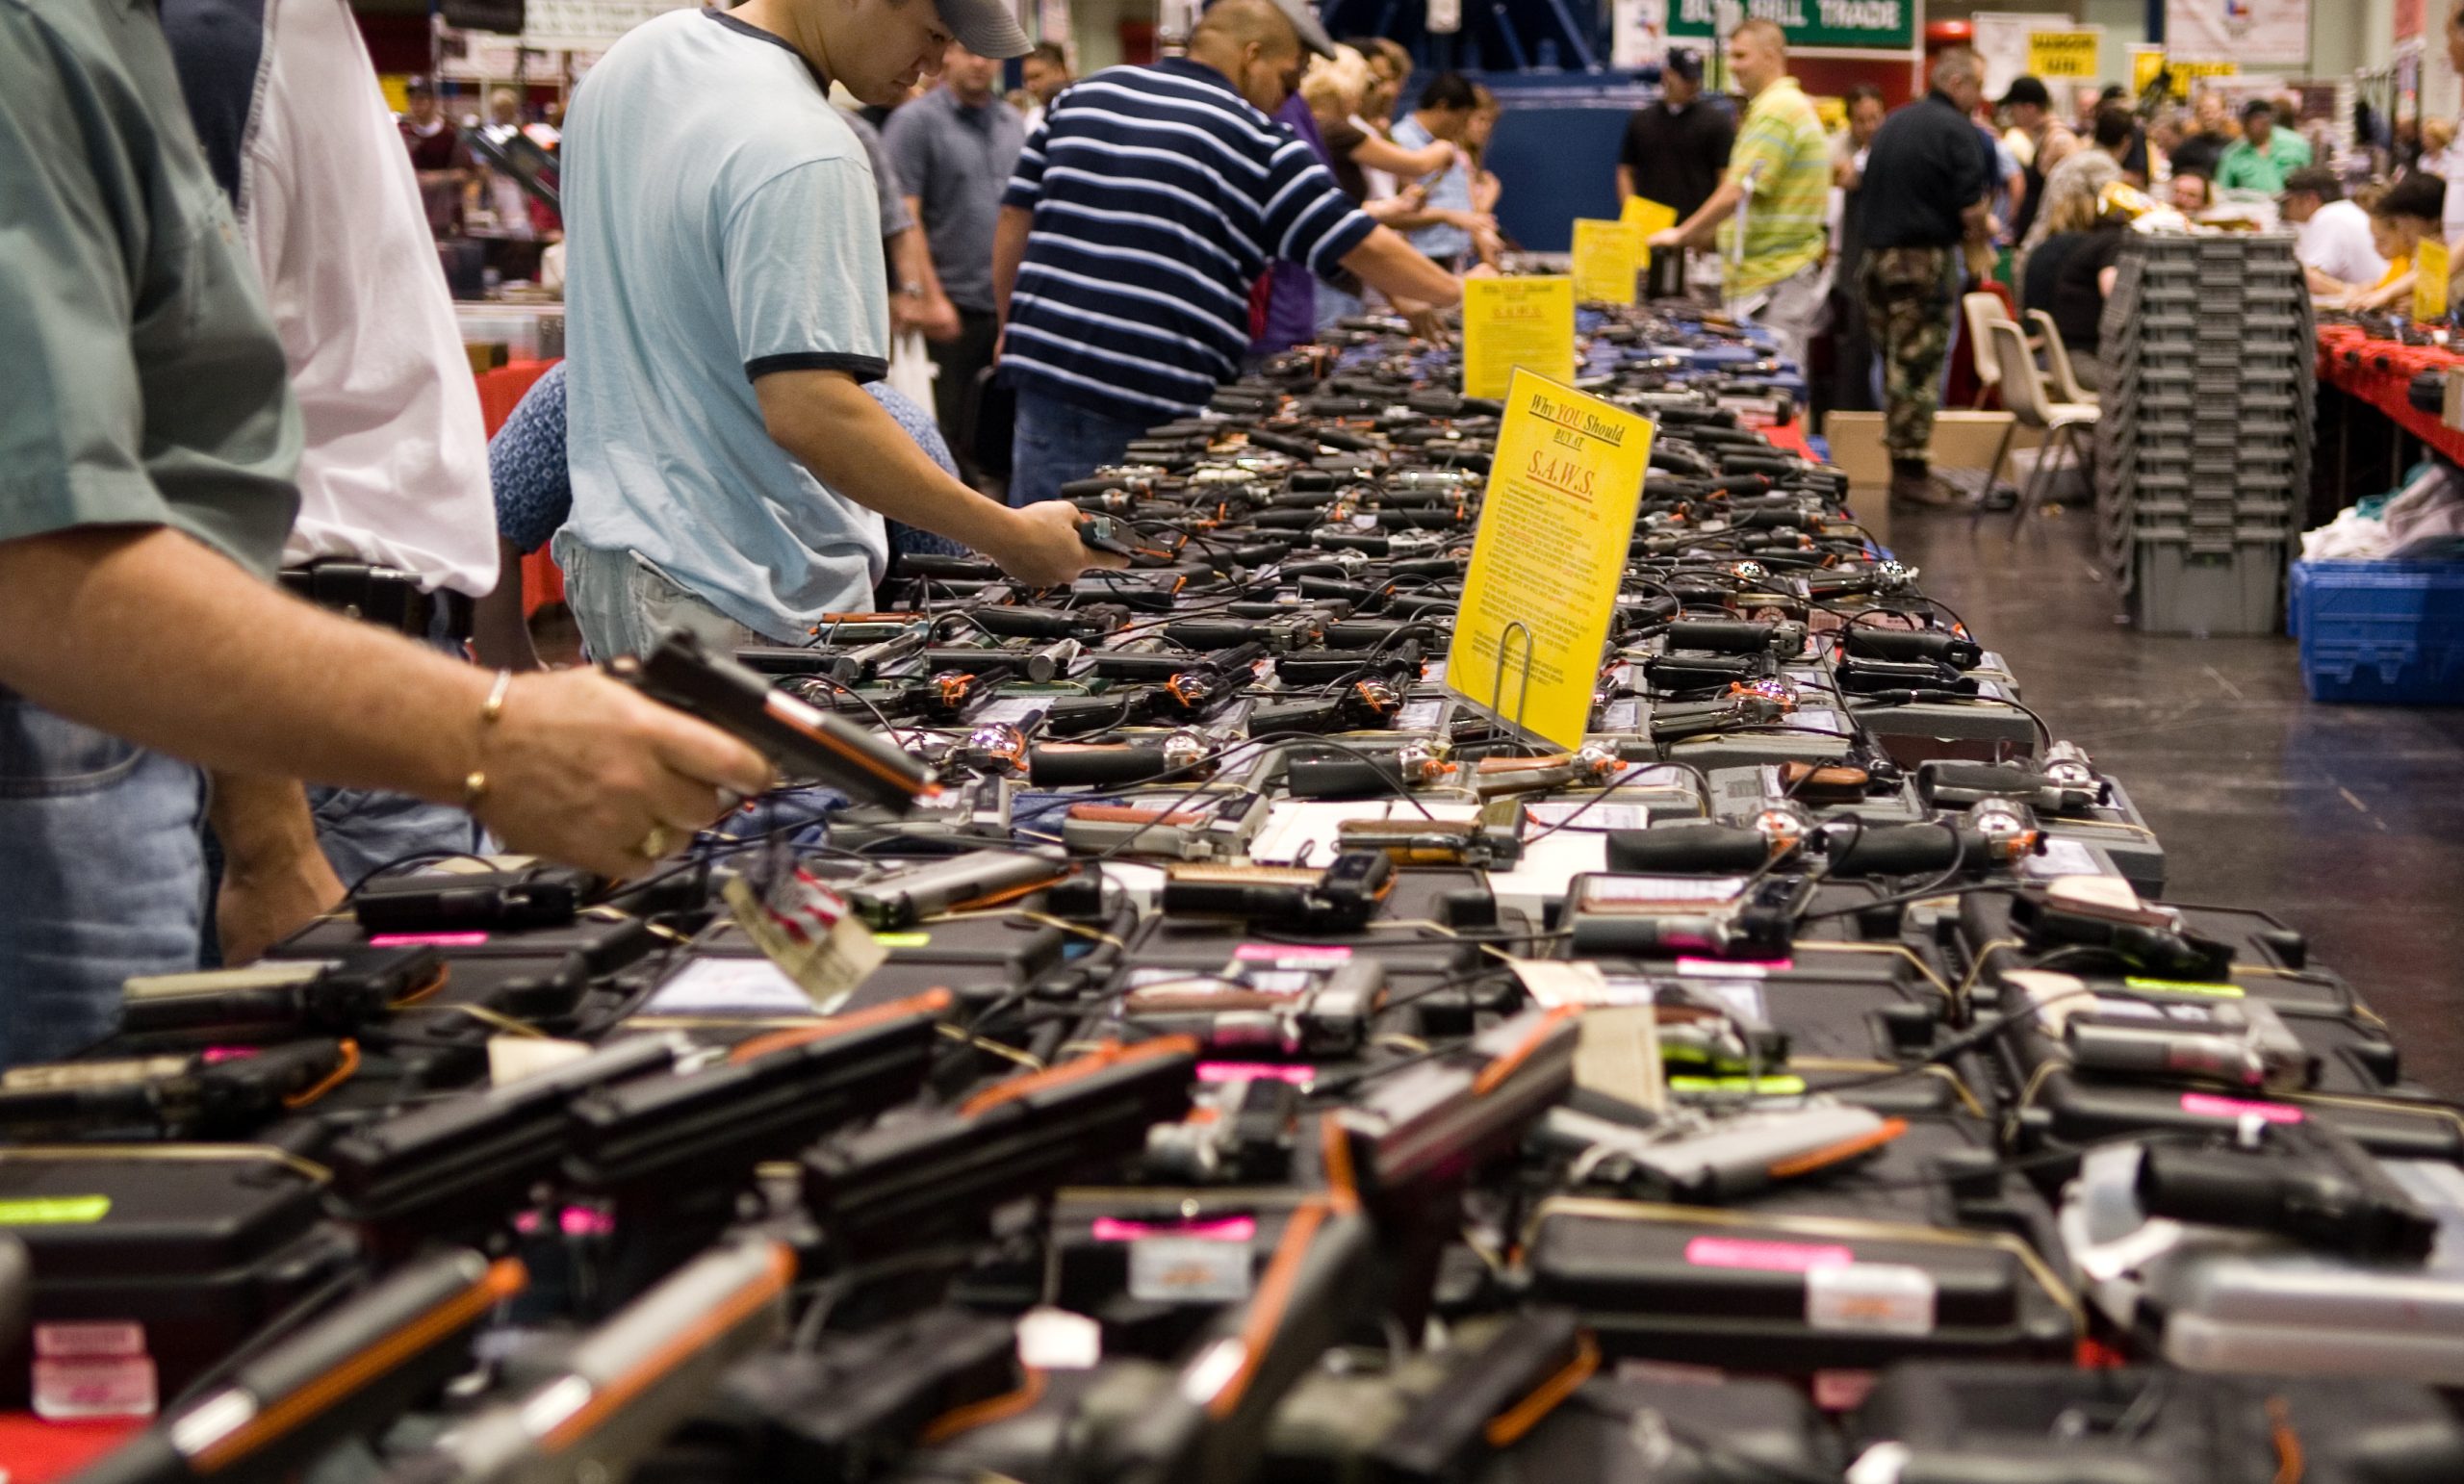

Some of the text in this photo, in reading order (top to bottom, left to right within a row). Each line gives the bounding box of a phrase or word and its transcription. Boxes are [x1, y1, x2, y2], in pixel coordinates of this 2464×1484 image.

[1817, 0, 1901, 30] TRADE
[1530, 394, 1625, 443] Why YOU Should
[1553, 428, 1585, 448] BUY AT
[1527, 450, 1594, 496] S.A.W.S.
